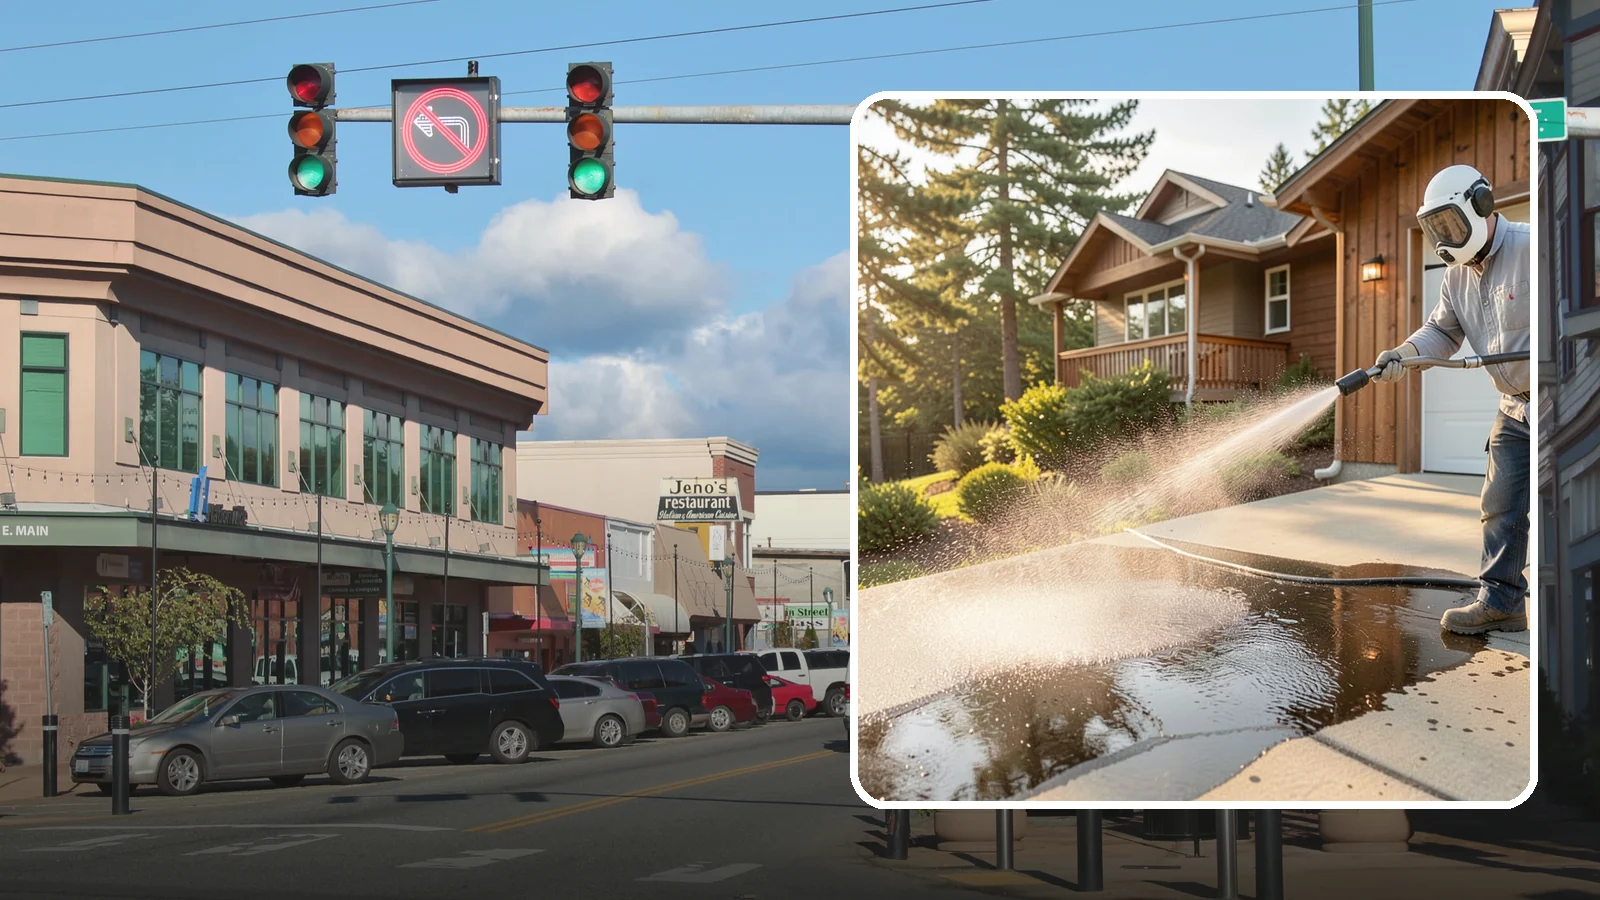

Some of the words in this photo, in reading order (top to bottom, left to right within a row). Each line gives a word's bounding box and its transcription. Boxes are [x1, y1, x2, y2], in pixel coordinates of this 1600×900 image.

[670, 480, 727, 494] Jeno's
[665, 496, 731, 509] restaurant
[659, 510, 681, 519] Italian
[686, 510, 714, 519] American
[715, 510, 737, 519] Cuisine
[2, 525, 13, 536] E.
[15, 525, 49, 536] MAIN
[797, 607, 828, 616] Street
